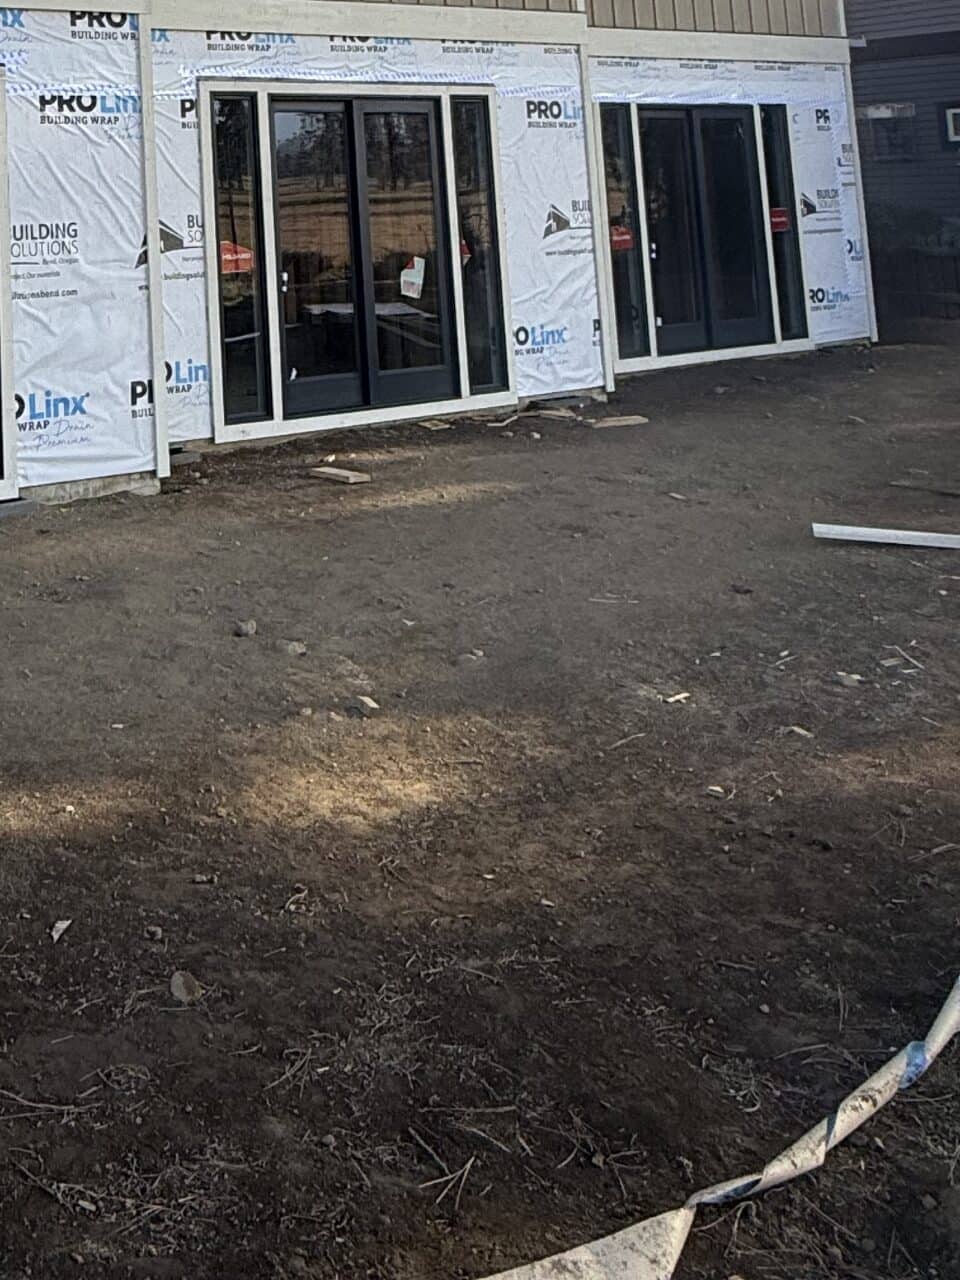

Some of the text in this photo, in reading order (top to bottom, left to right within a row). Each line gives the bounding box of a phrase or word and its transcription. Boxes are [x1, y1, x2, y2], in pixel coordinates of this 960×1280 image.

[71, 30, 118, 41] BUILDING
[207, 43, 271, 52] BUILDING WRAP
[40, 116, 119, 125] BUILDING WRAP
[12, 222, 78, 241] UILDING
[11, 240, 79, 257] OLUTIONS
[166, 384, 192, 394] WRAP
[18, 420, 50, 432] WRAP
